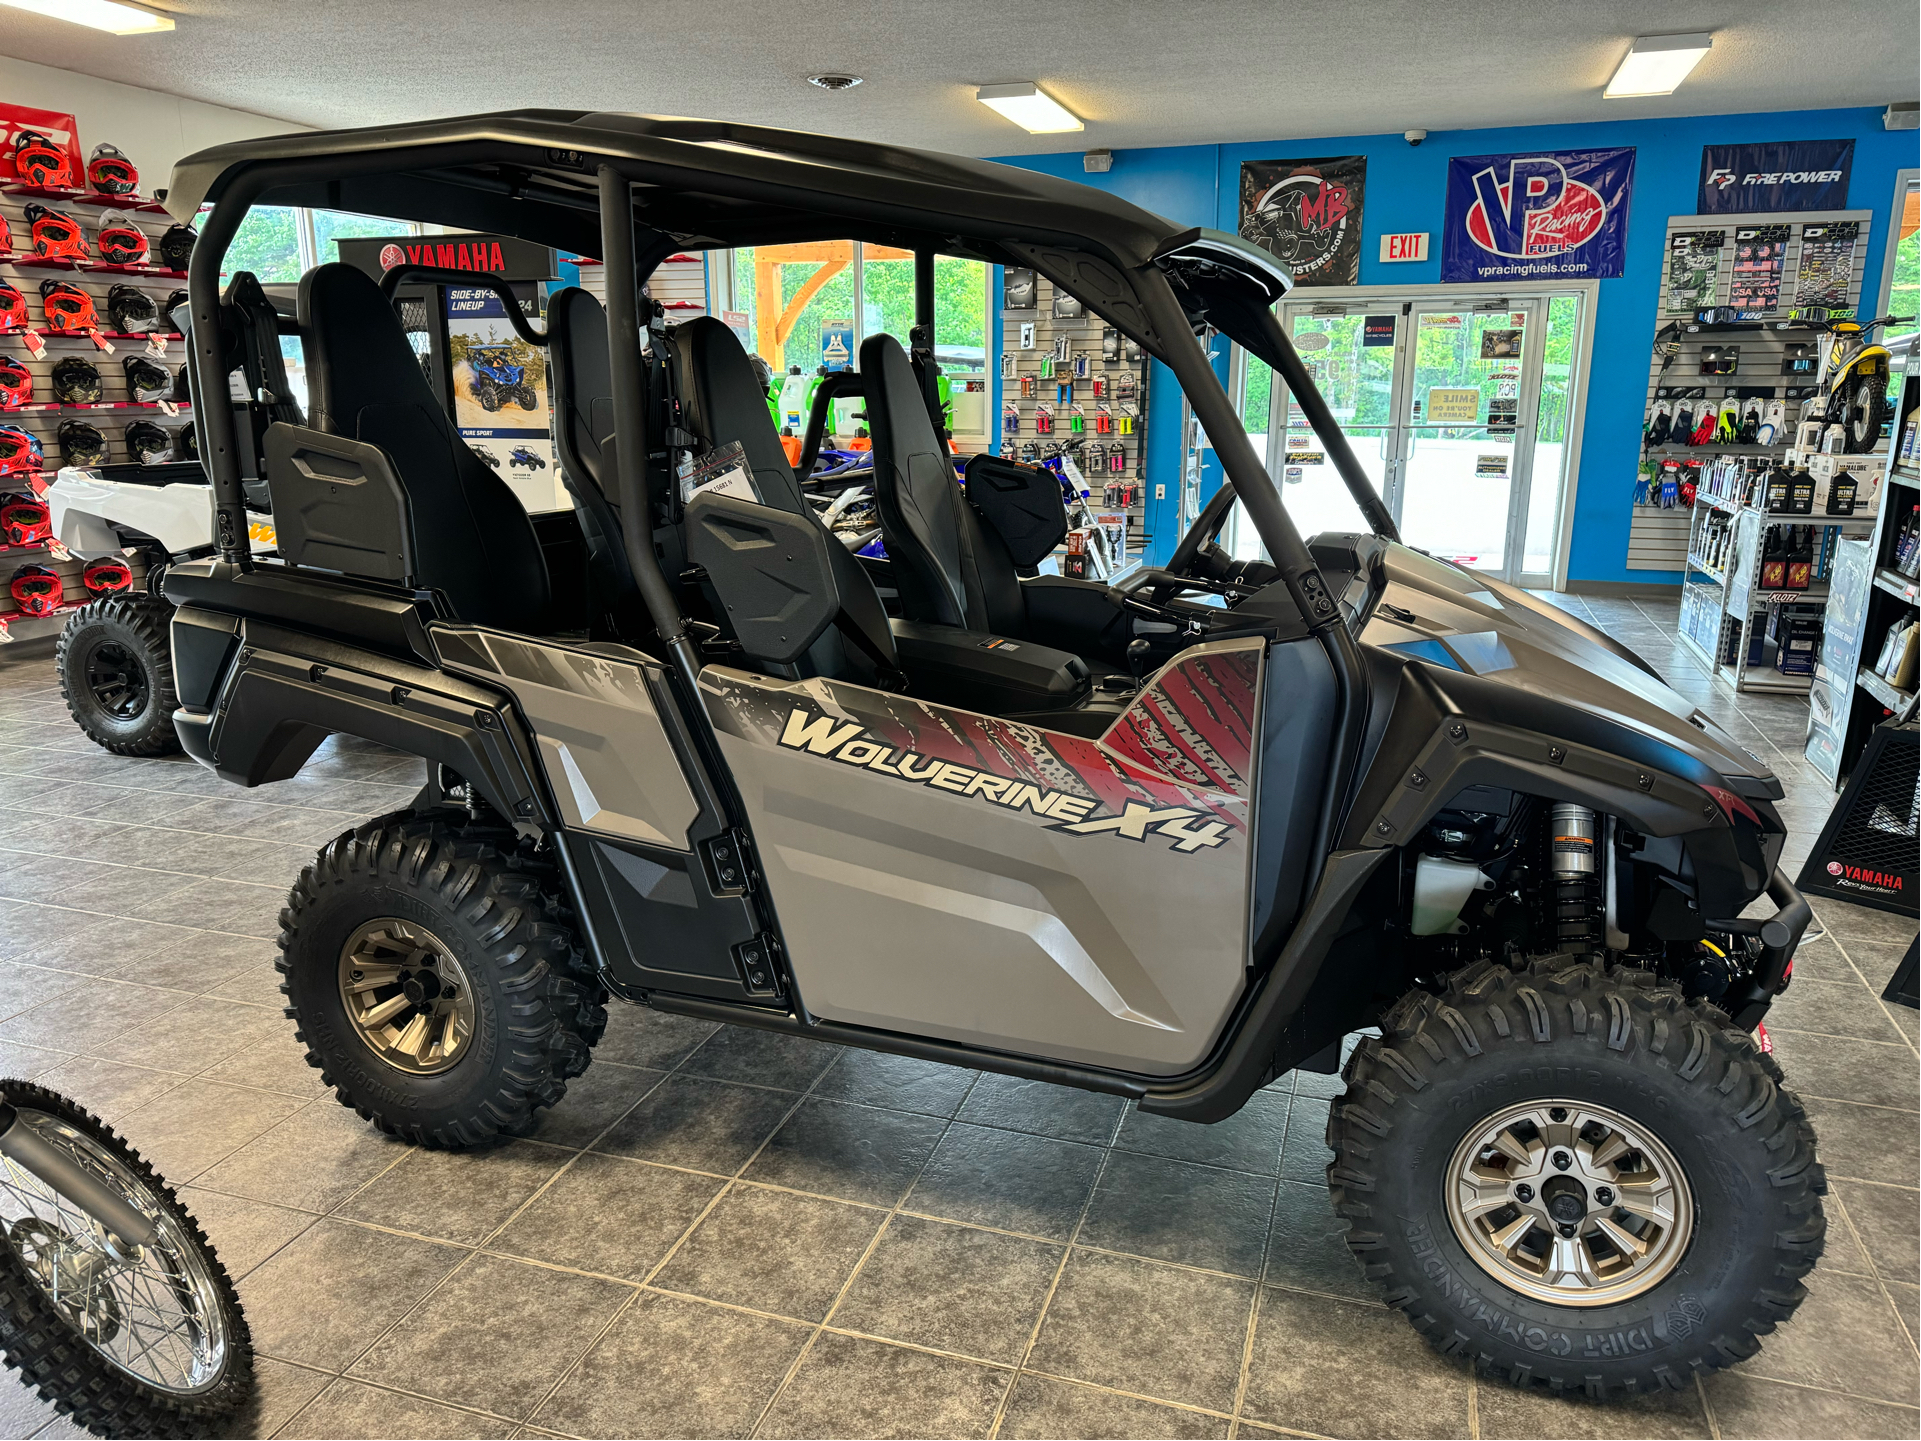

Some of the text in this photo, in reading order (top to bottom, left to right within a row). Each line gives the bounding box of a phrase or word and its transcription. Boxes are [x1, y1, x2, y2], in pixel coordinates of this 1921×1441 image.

[1301, 180, 1349, 231] MB
[1472, 158, 1568, 257] VP
[1530, 206, 1603, 244] Racing
[406, 242, 506, 271] YAMAHA
[1289, 230, 1344, 274] USTERS.COM
[1390, 234, 1422, 259] EXIT
[1528, 243, 1576, 254] FUELS
[1478, 263, 1588, 277] vpracingfuels.com
[450, 290, 500, 300] SIDE-BY-S
[1732, 288, 1752, 296] USA
[1758, 288, 1777, 296] USA
[451, 301, 484, 310] LINEUP
[1768, 594, 1797, 602] KLOTZ
[778, 708, 1236, 854] WOLVERINE X4
[1845, 865, 1902, 890] YAMAHA
[1404, 1220, 1654, 1356] DIRT COMMANDER
